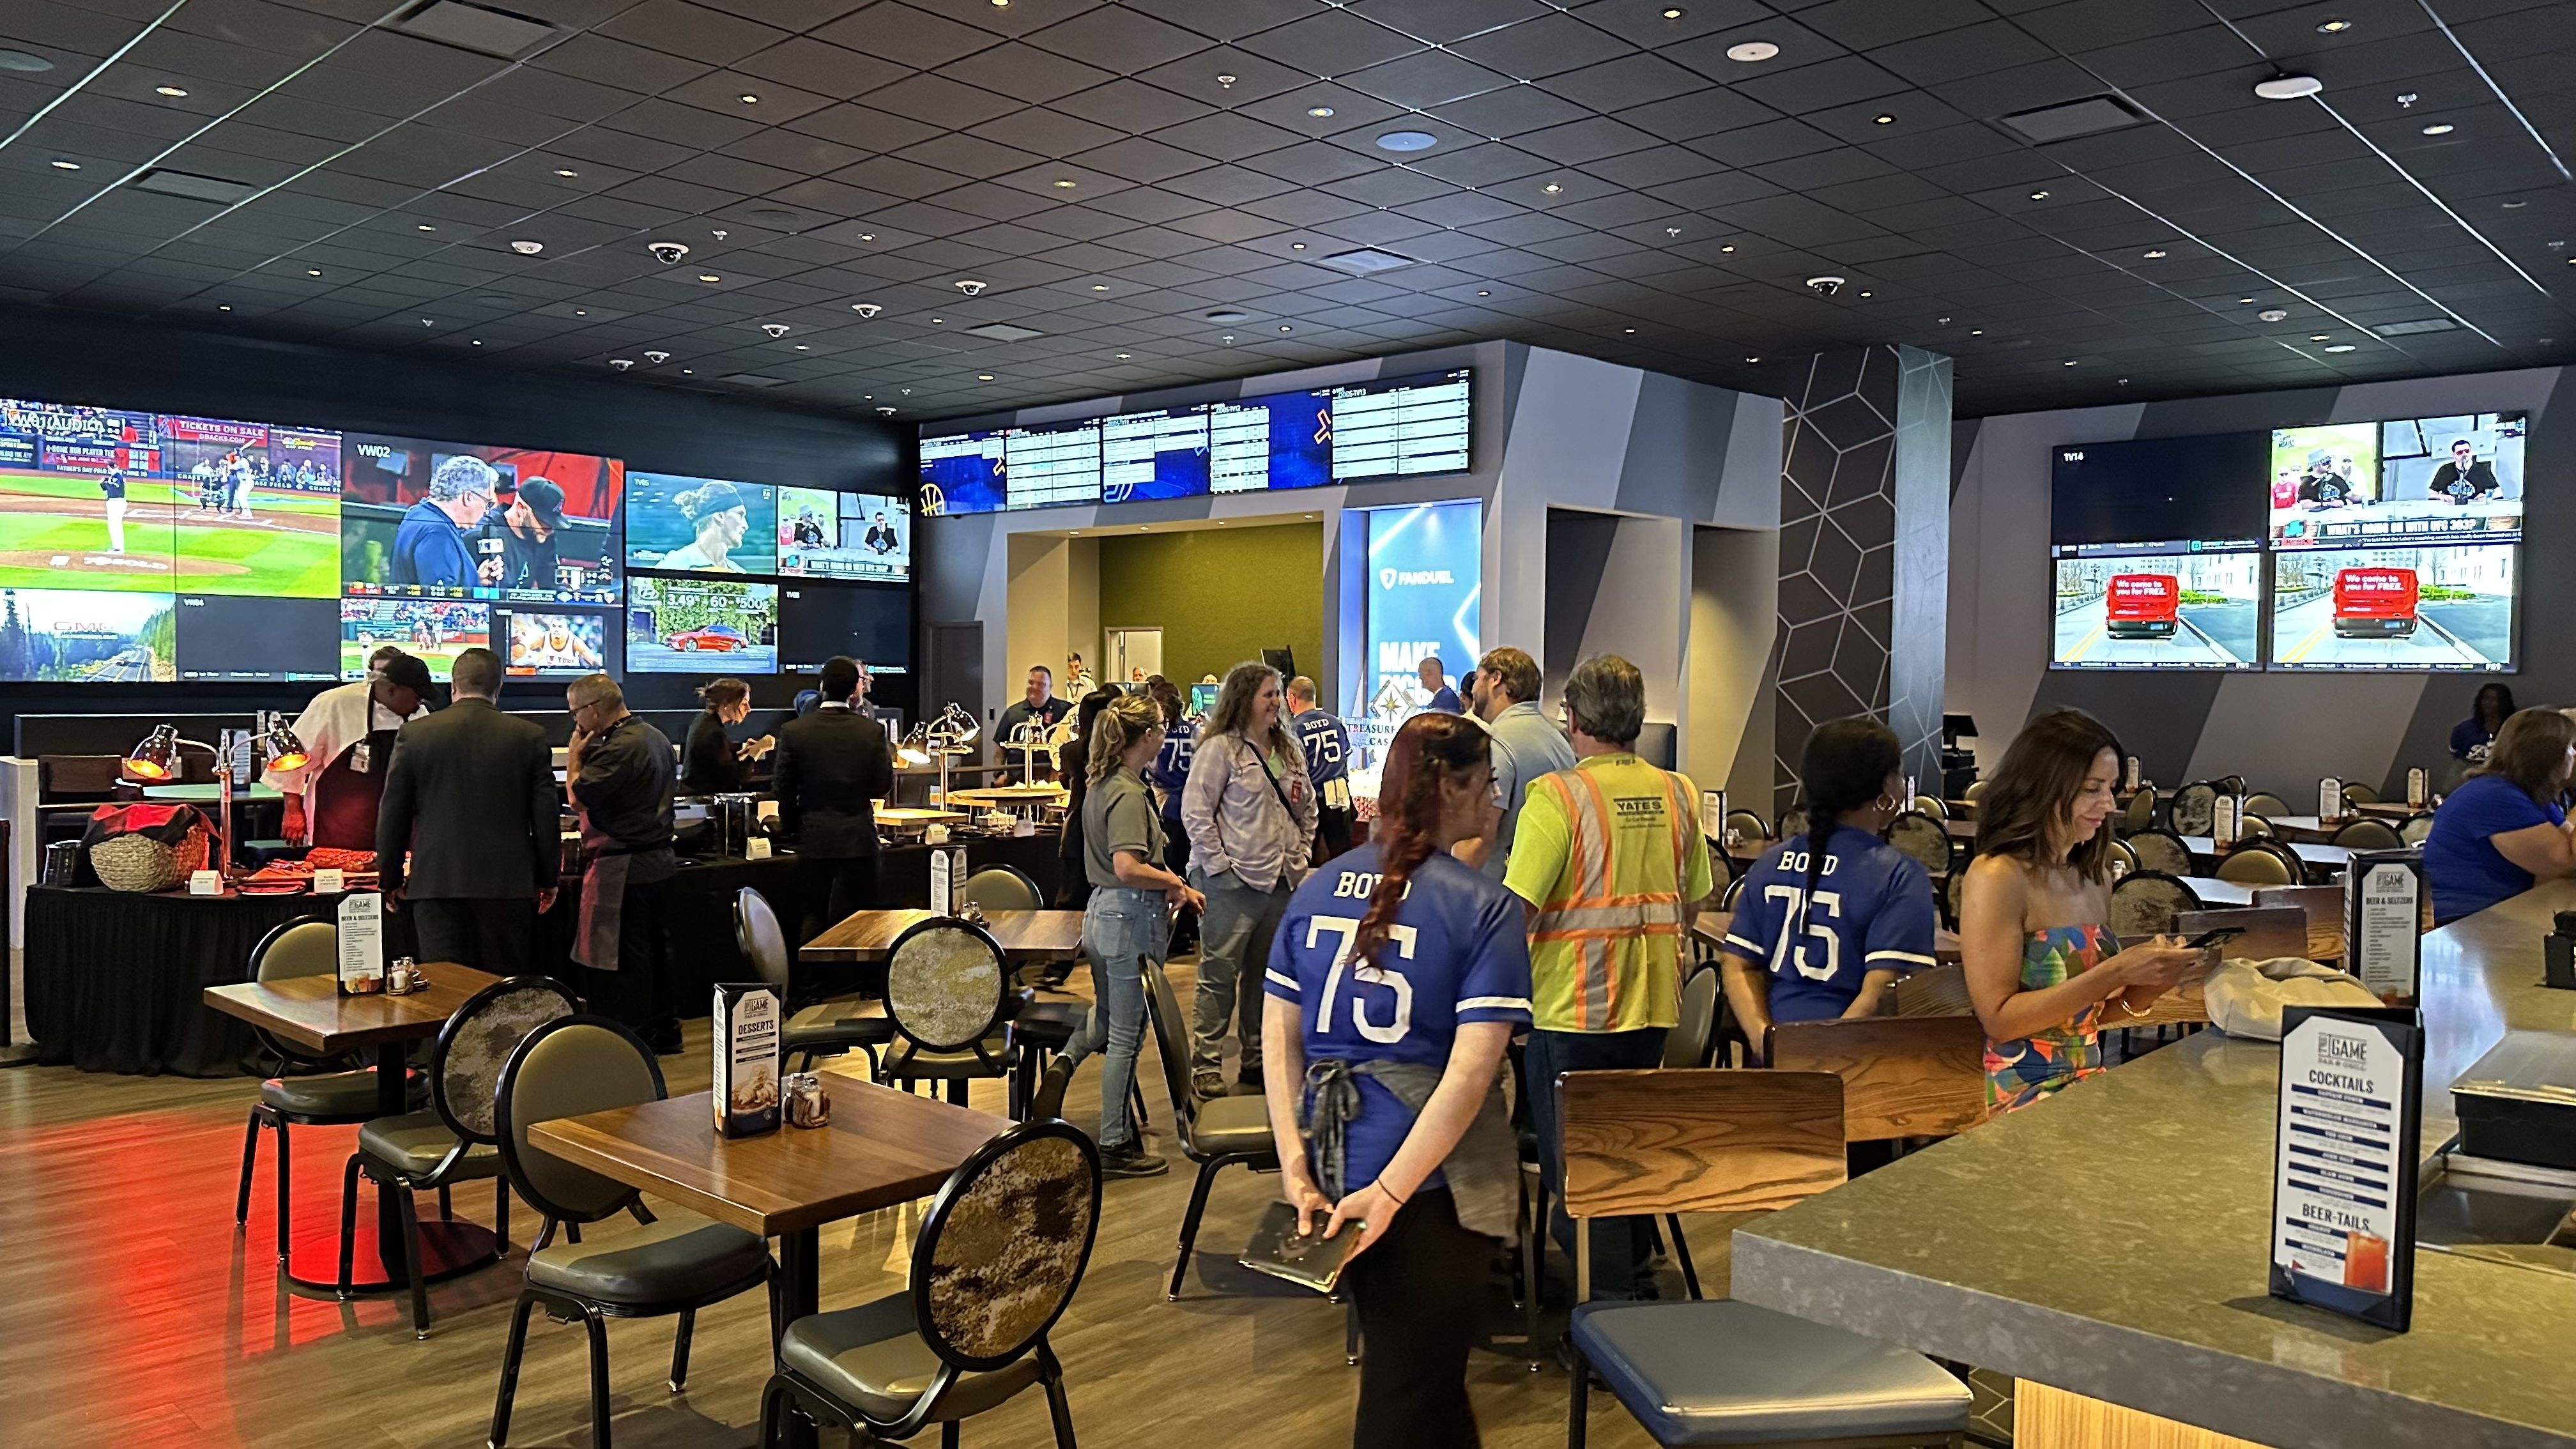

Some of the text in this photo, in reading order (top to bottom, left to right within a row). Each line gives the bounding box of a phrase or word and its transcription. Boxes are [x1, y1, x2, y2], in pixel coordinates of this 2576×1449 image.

[180, 421, 264, 436] TICKETS ON SALE
[199, 433, 245, 443] DBACKS.COM
[357, 444, 390, 458] VW02
[2064, 452, 2083, 462] TV14
[2326, 522, 2360, 536] WHAT'S
[2406, 520, 2428, 533] WITH
[2430, 519, 2448, 532] UFC
[1399, 570, 1454, 586] FANDUEL
[2116, 579, 2129, 588] We
[2345, 575, 2361, 583] We
[2345, 582, 2404, 592] you for FREE.
[710, 596, 727, 608] 60
[1303, 718, 1329, 730] BOYD
[1303, 729, 1341, 767] 75
[1369, 737, 1388, 746] CAS
[1162, 738, 1195, 772] 75
[1616, 801, 1662, 811] YATES
[1777, 850, 1839, 875] BOD
[1765, 884, 1840, 981] 75
[1305, 915, 1418, 1043] 75
[739, 1020, 774, 1035] DESSERTS
[2332, 1038, 2367, 1061] GAME
[2309, 1070, 2373, 1094] COCKTAILS
[2303, 1203, 2370, 1231] BEER-TAILS
